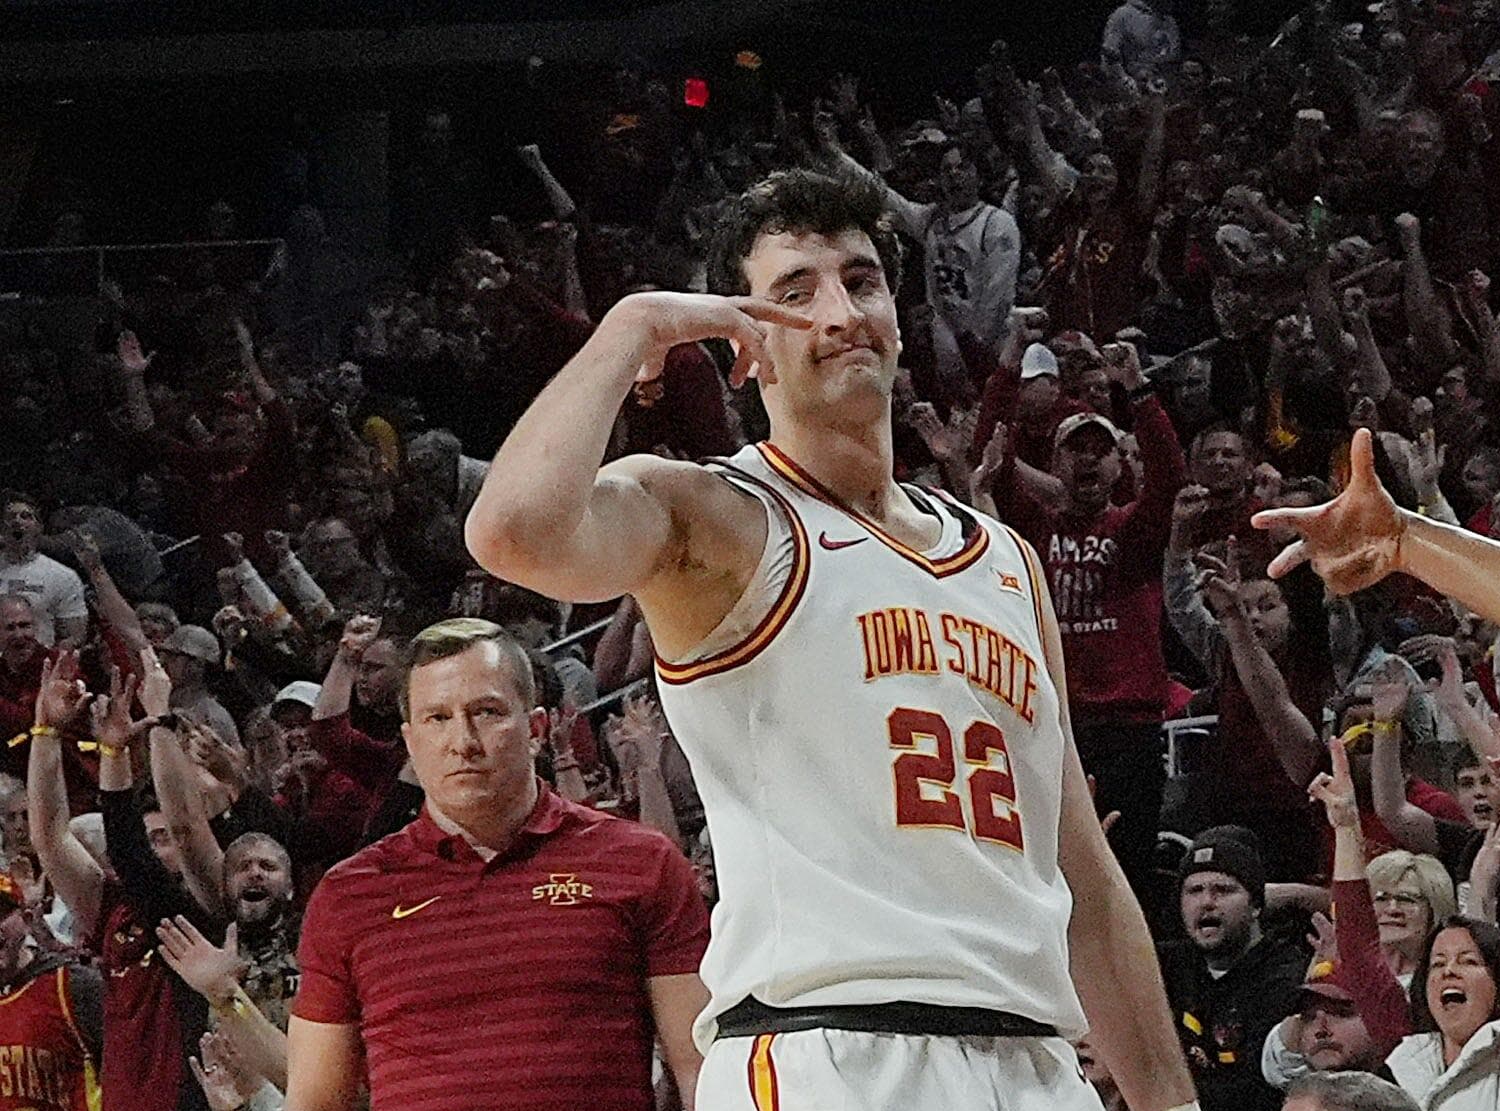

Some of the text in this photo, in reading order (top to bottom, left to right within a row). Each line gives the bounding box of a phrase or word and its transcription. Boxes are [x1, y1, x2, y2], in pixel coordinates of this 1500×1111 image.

[856, 606, 1040, 729] IOWA STATE
[886, 705, 1027, 854] 22
[532, 883, 593, 900] STATE
